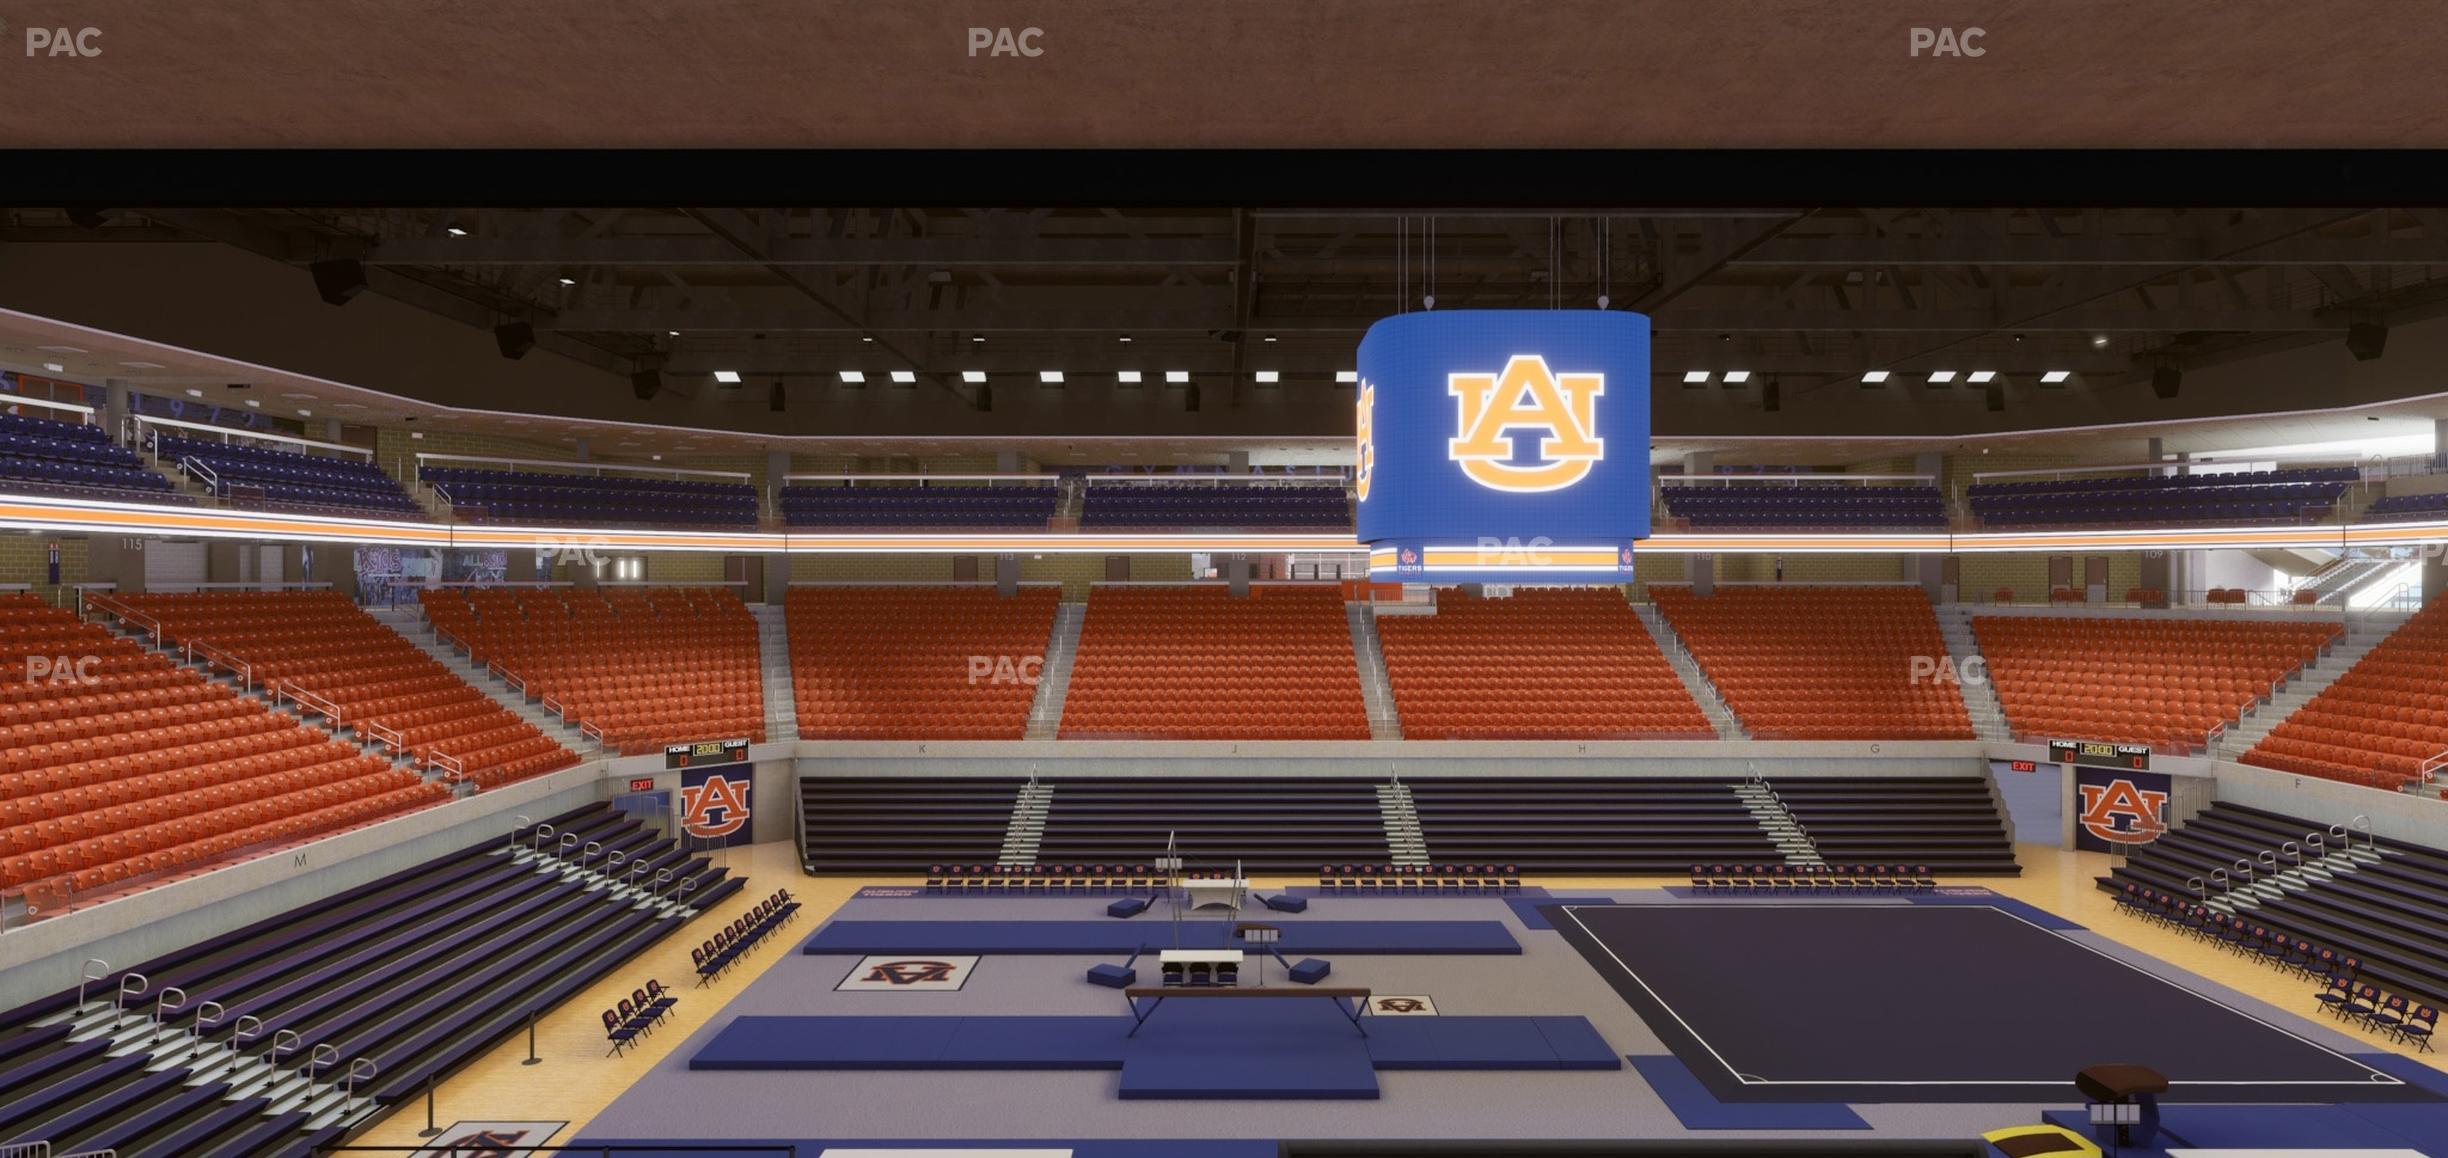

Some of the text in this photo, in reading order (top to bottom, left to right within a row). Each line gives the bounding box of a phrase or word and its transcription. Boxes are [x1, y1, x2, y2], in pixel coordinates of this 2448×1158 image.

[122, 538, 143, 551] 115
[668, 745, 691, 754] HOME
[724, 739, 748, 748] GUEST
[918, 744, 927, 753] K
[1578, 744, 1586, 753] H
[1870, 743, 1880, 754] G
[2052, 740, 2077, 749] HOME
[2118, 746, 2148, 754] GUEST
[2012, 762, 2035, 772] EXIT
[631, 780, 653, 791] EXIT
[2295, 778, 2302, 789] F
[293, 853, 308, 868] M
